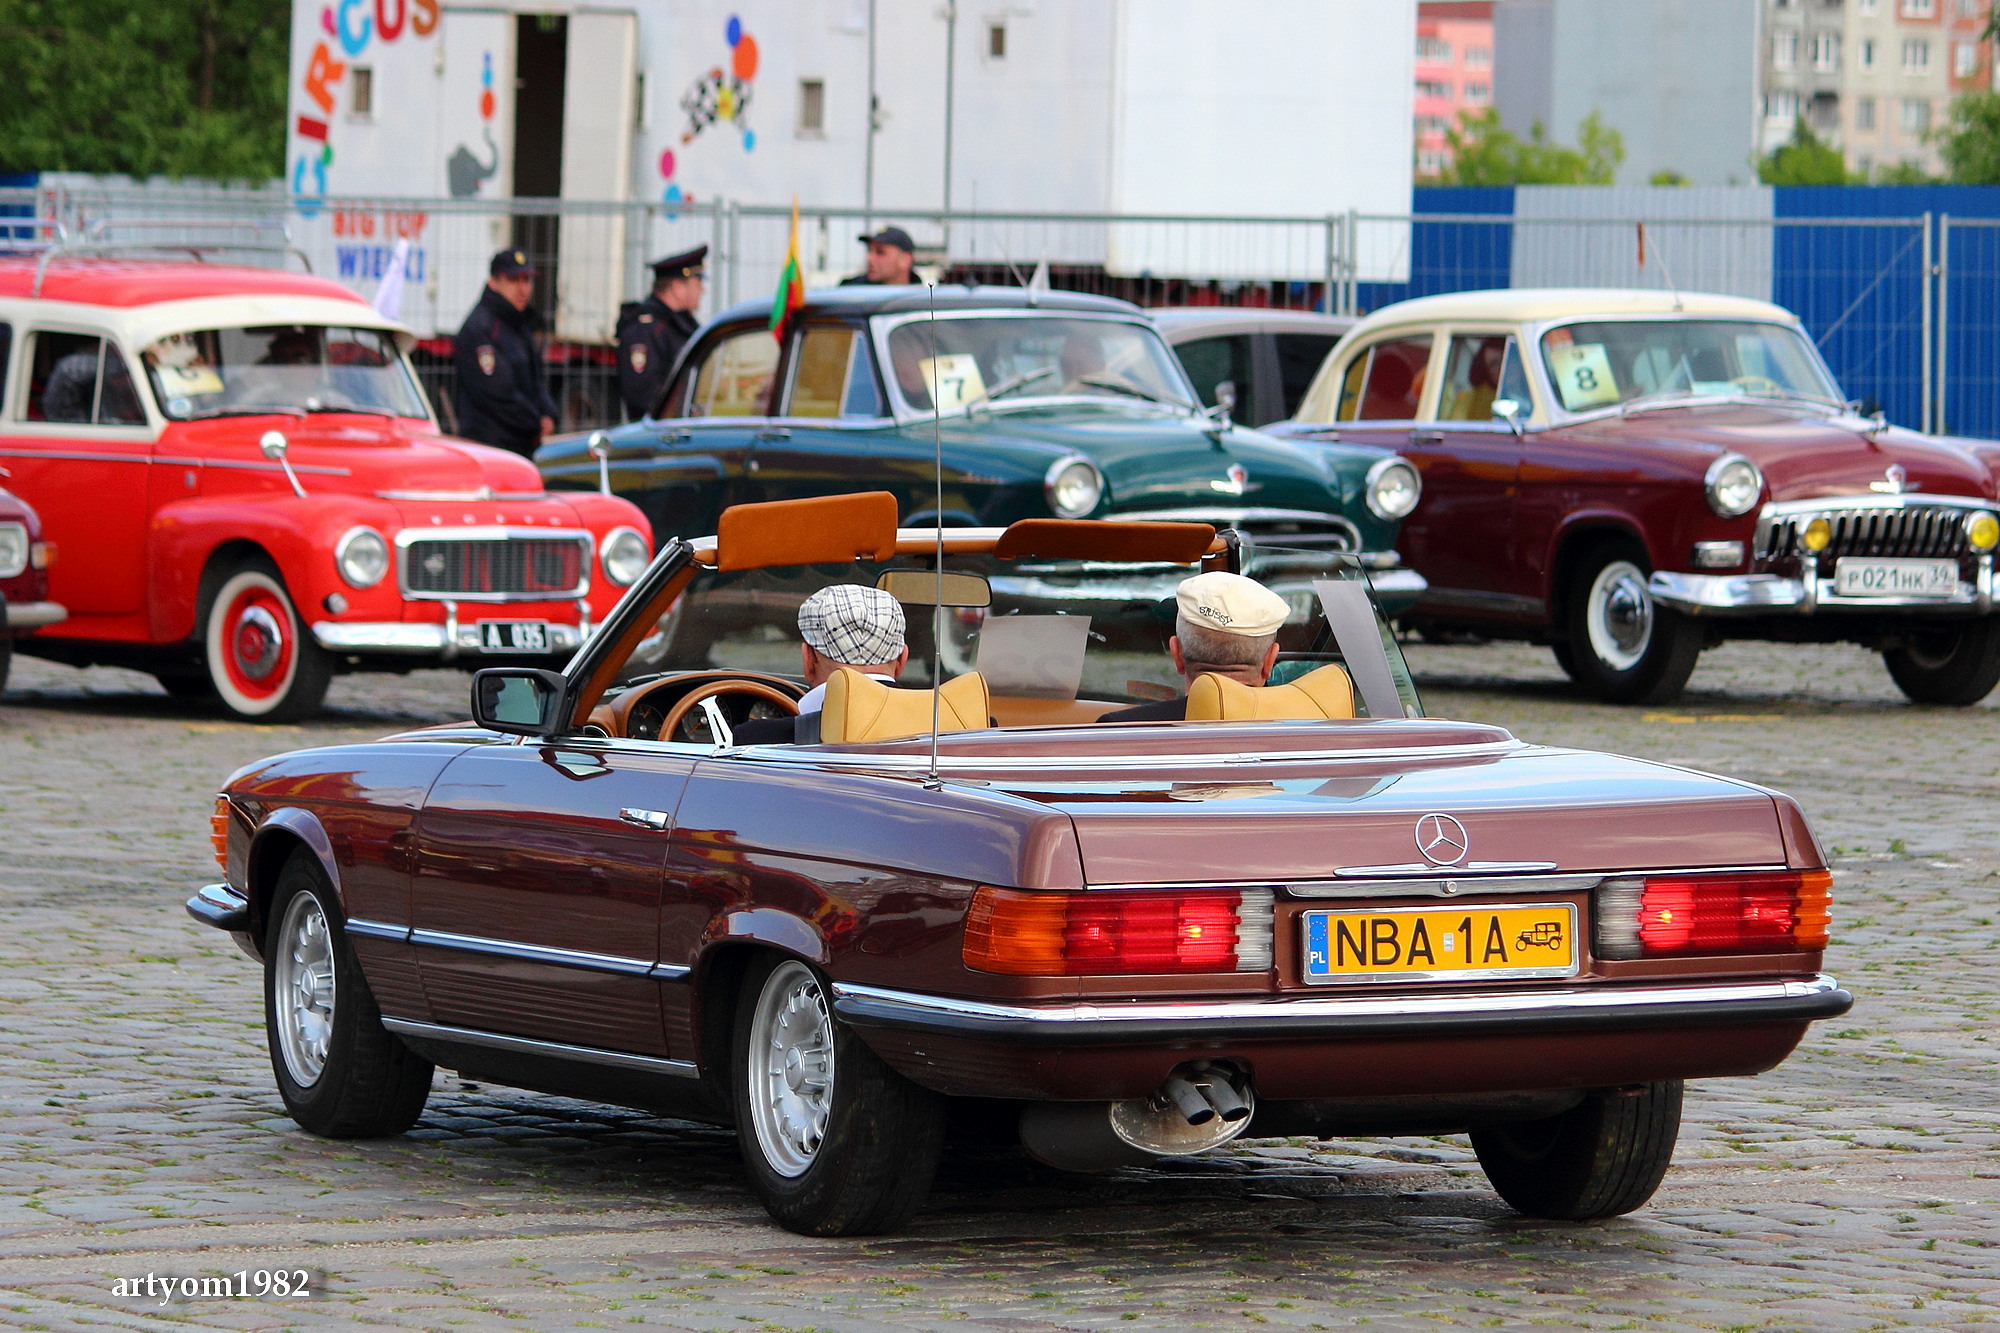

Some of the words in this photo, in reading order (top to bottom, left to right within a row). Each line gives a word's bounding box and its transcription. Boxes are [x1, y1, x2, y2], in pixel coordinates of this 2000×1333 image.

[293, 0, 439, 220] CIRCUS
[335, 245, 425, 280] WIEI
[944, 376, 964, 402] 7
[1575, 366, 1598, 391] 8
[1336, 917, 1436, 967] NBA
[1457, 915, 1509, 964] 1A
[1310, 951, 1326, 964] PL
